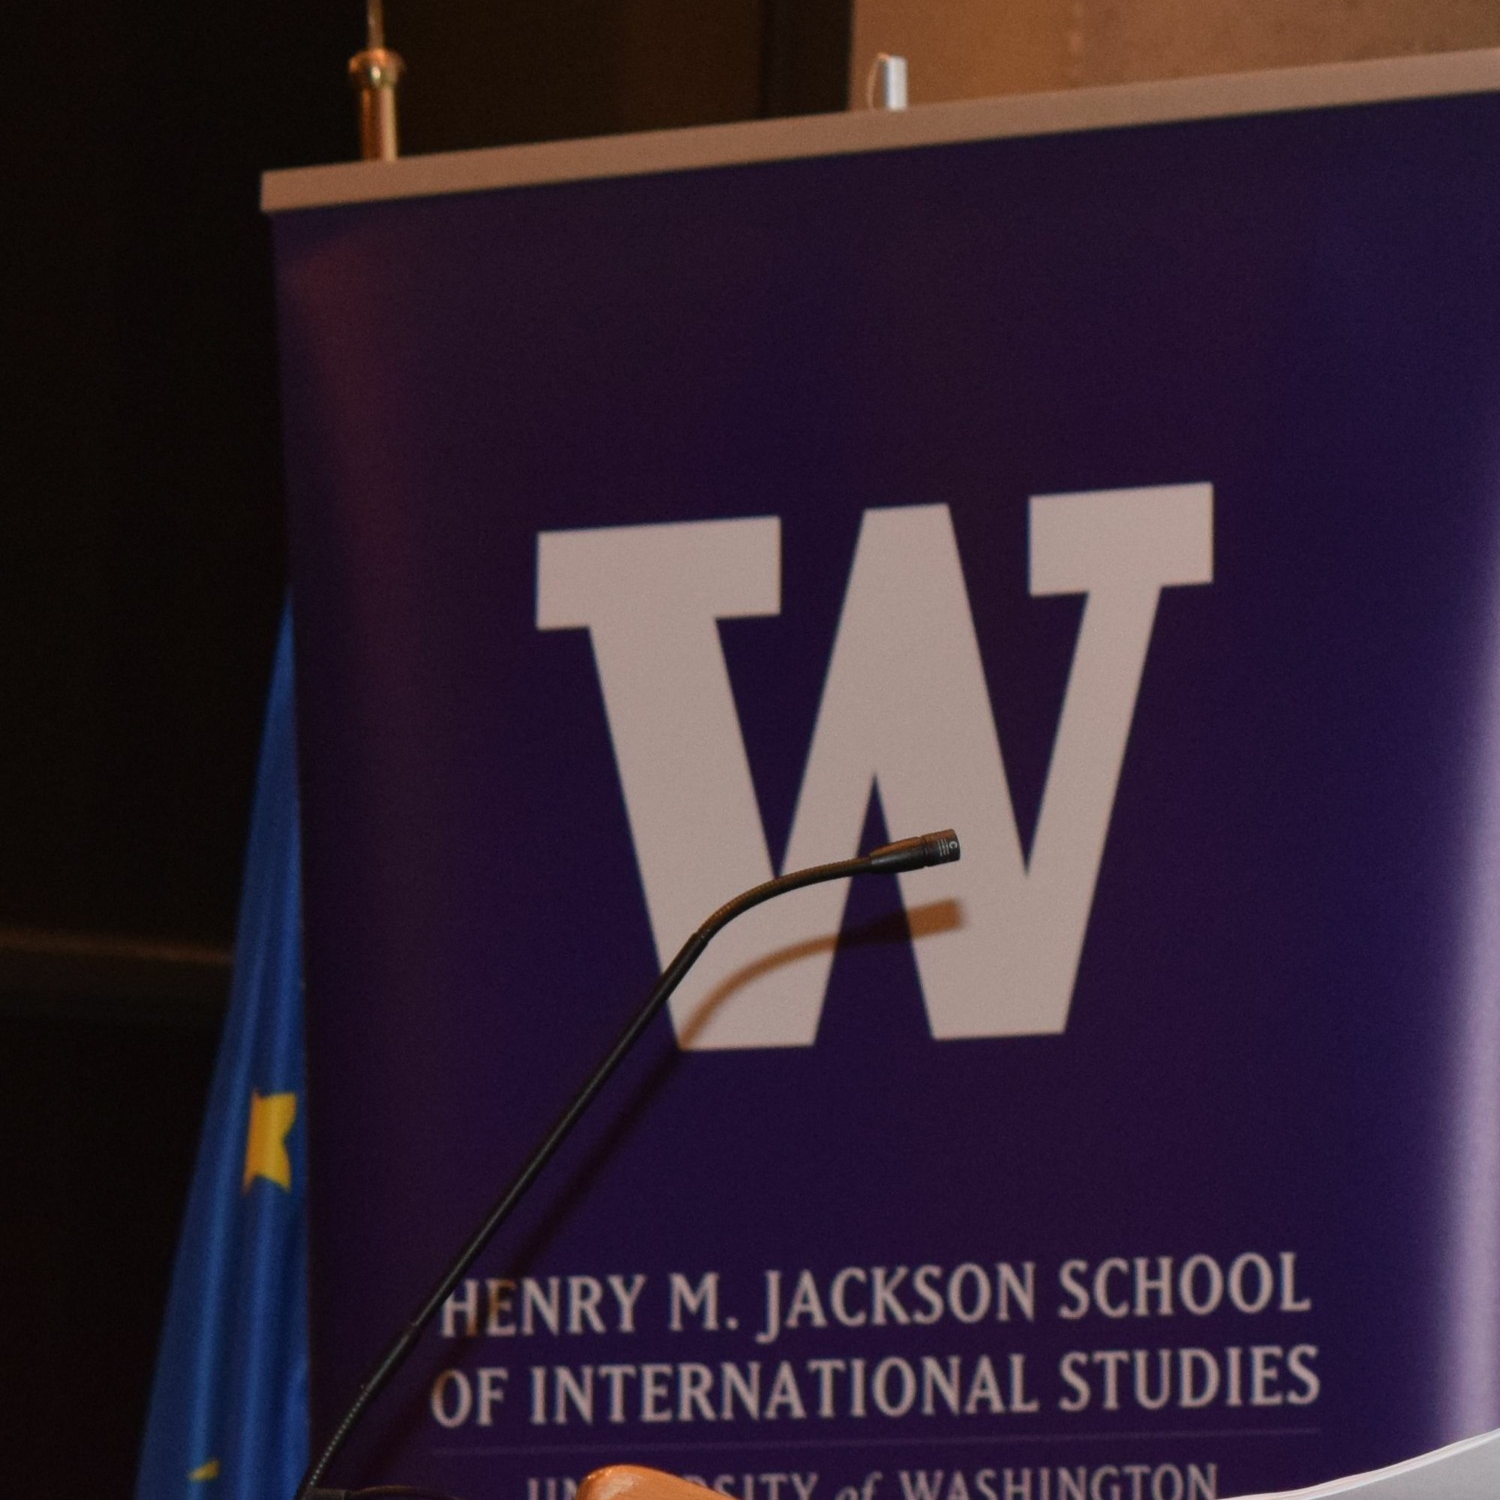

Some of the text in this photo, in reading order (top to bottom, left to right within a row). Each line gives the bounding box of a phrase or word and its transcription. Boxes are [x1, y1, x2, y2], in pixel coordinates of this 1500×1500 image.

[535, 481, 1213, 1051] W
[441, 1252, 1311, 1344] HENRY M. JACKSON SCHOOL
[431, 1344, 1320, 1428] OF INTERNATIONAL STUDIES
[900, 1463, 1217, 1500] WASHINGTON
